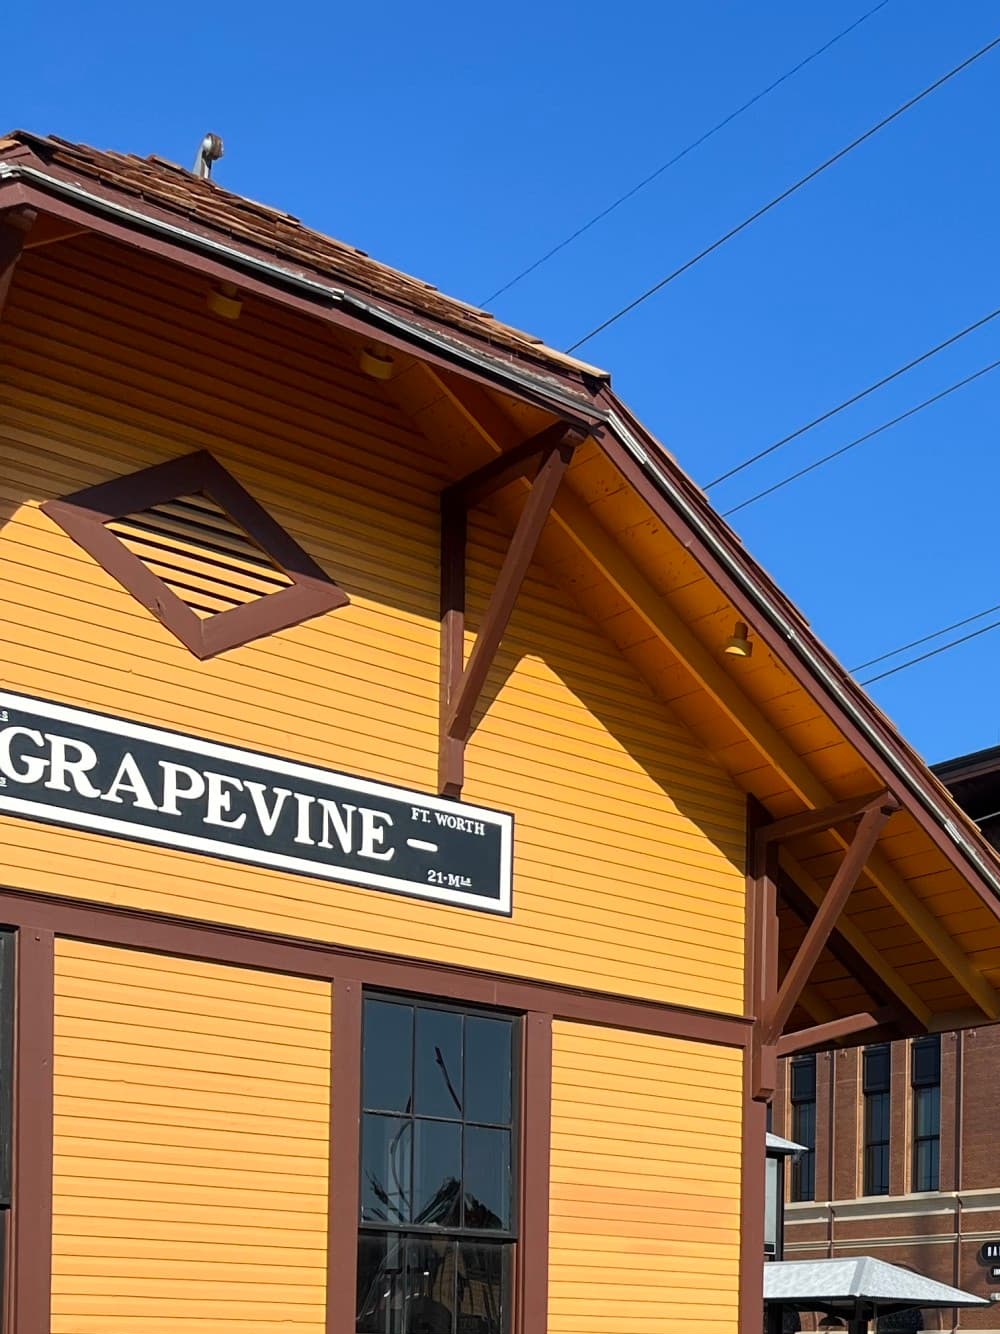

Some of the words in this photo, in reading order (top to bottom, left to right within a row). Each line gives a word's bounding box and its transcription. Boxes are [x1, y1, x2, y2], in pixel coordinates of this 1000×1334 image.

[0, 726, 395, 861] GRAPEVINE
[411, 807, 431, 824] FT.
[434, 812, 486, 836] WORTH
